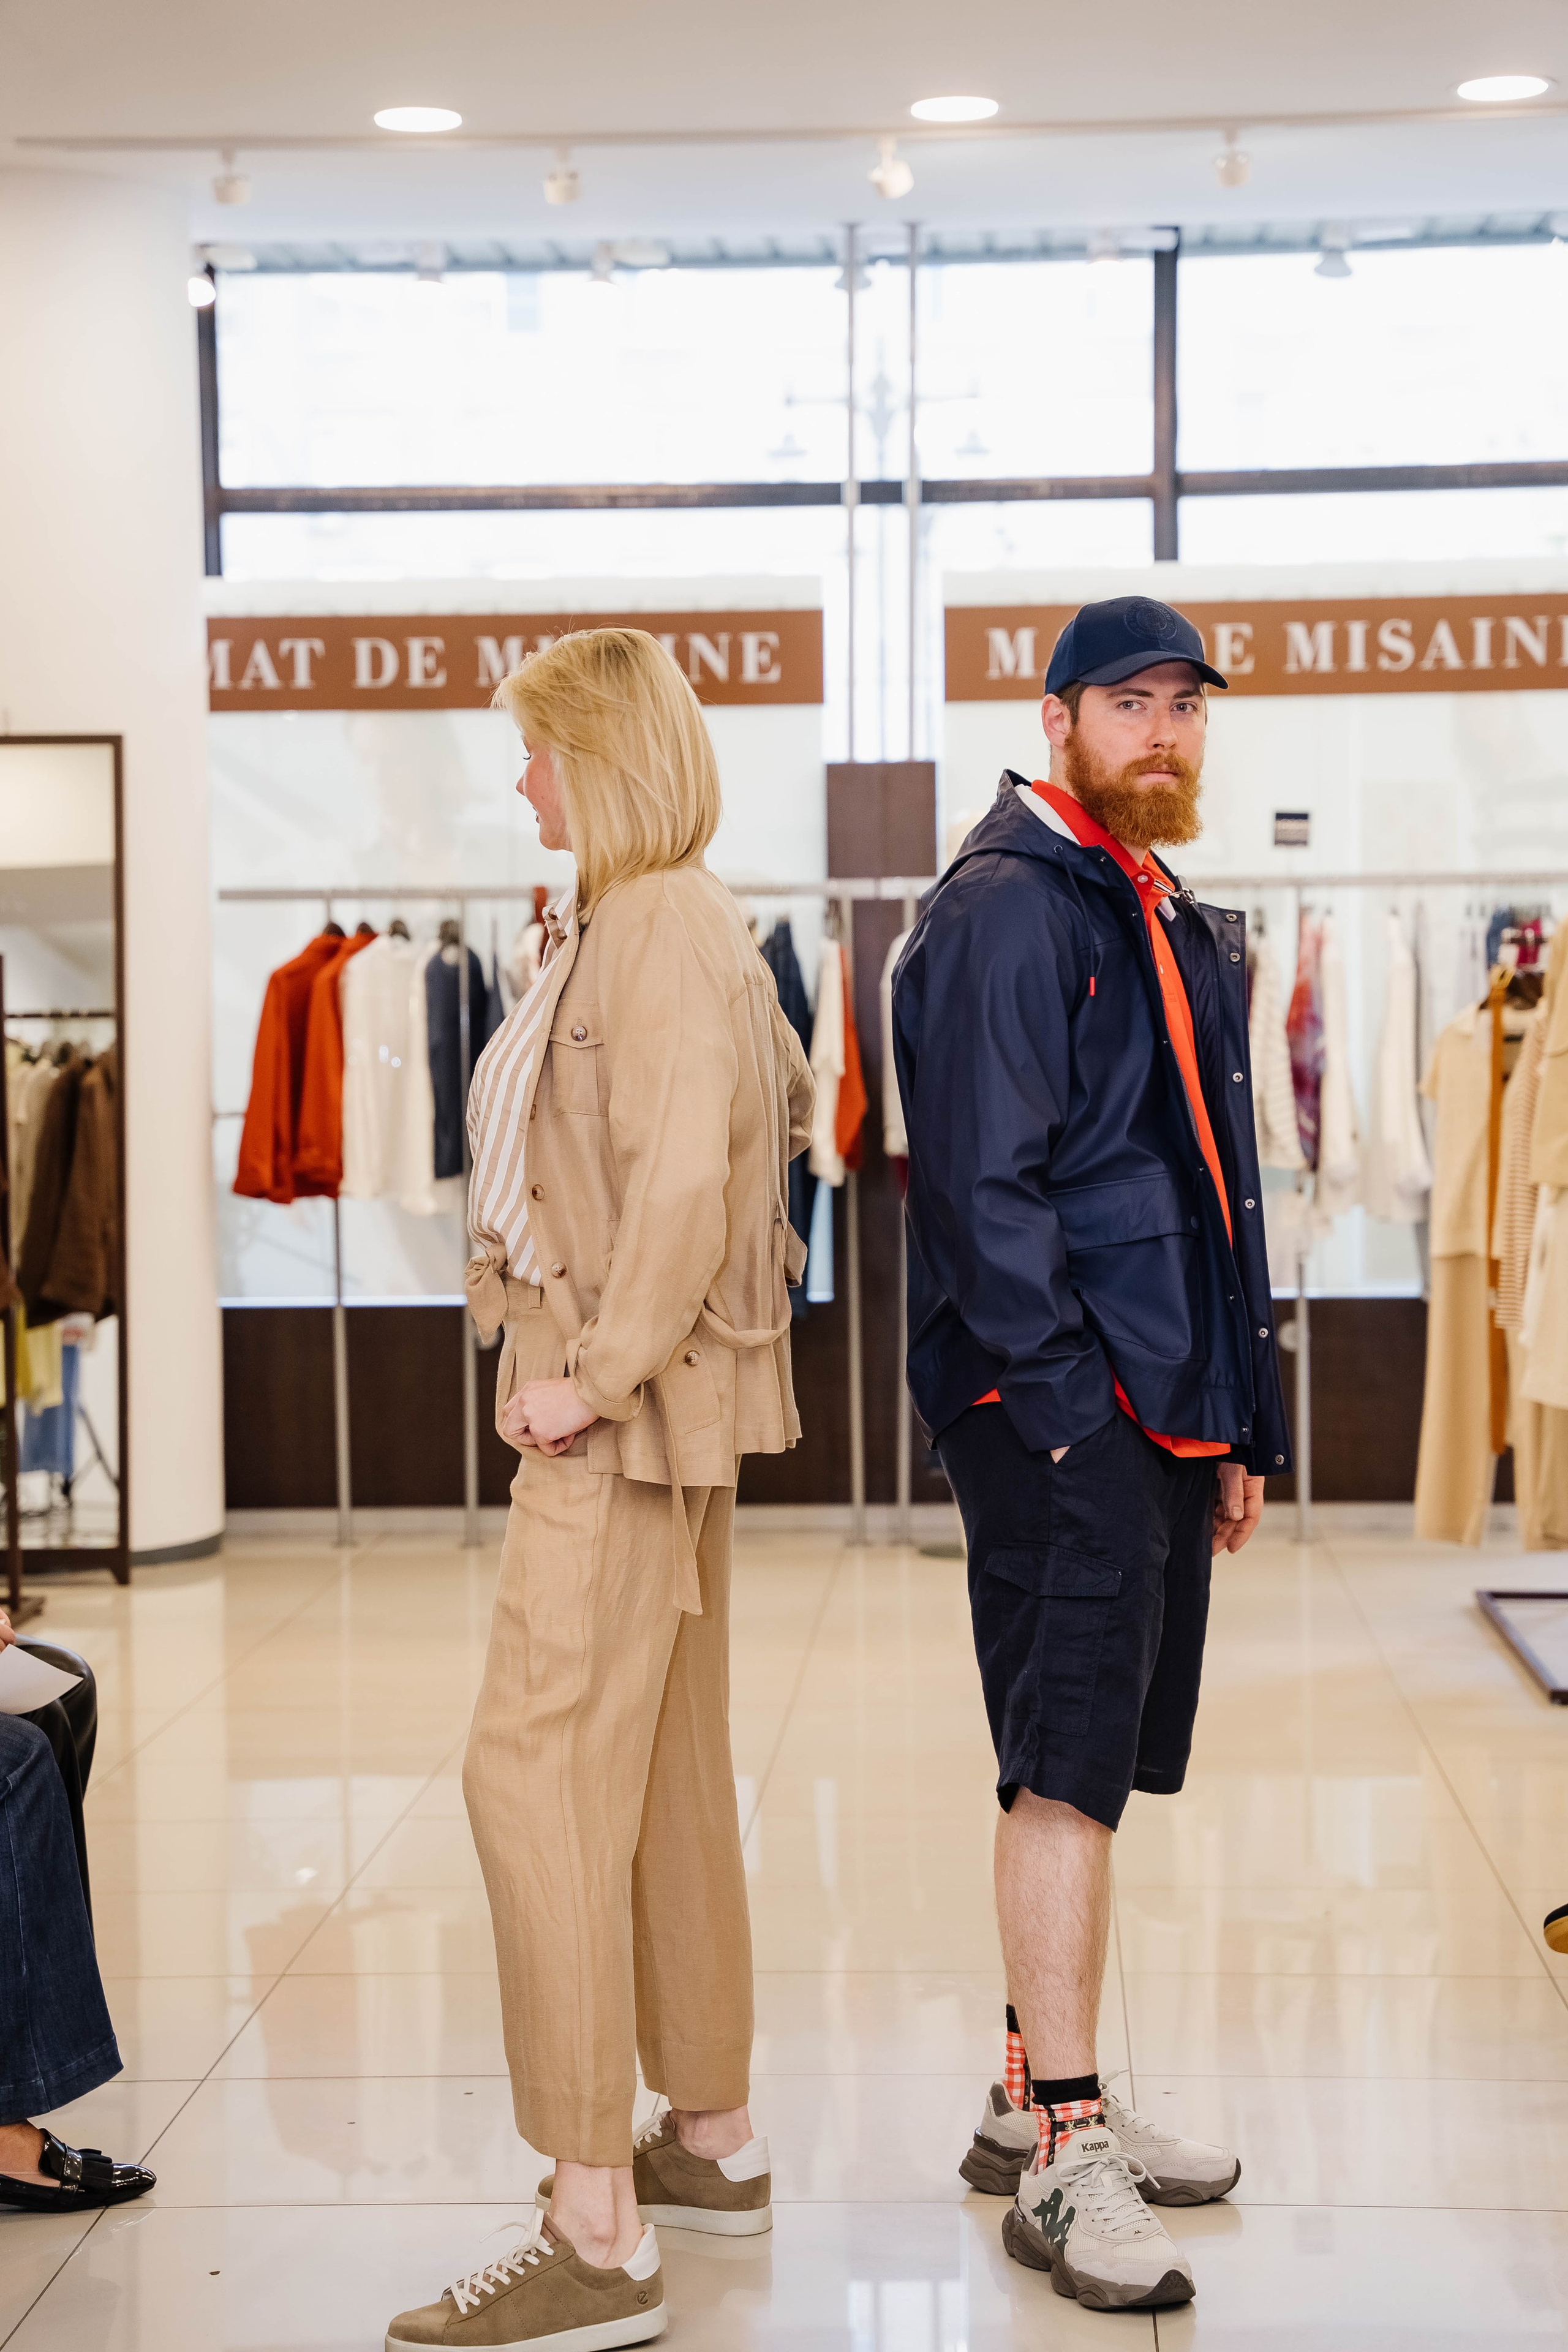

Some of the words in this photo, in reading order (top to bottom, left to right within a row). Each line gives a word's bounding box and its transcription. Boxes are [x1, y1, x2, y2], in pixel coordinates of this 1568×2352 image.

[352, 636, 448, 689] DE
[1281, 614, 1568, 674] MISAIN
[1081, 2141, 1109, 2152] Kappa
